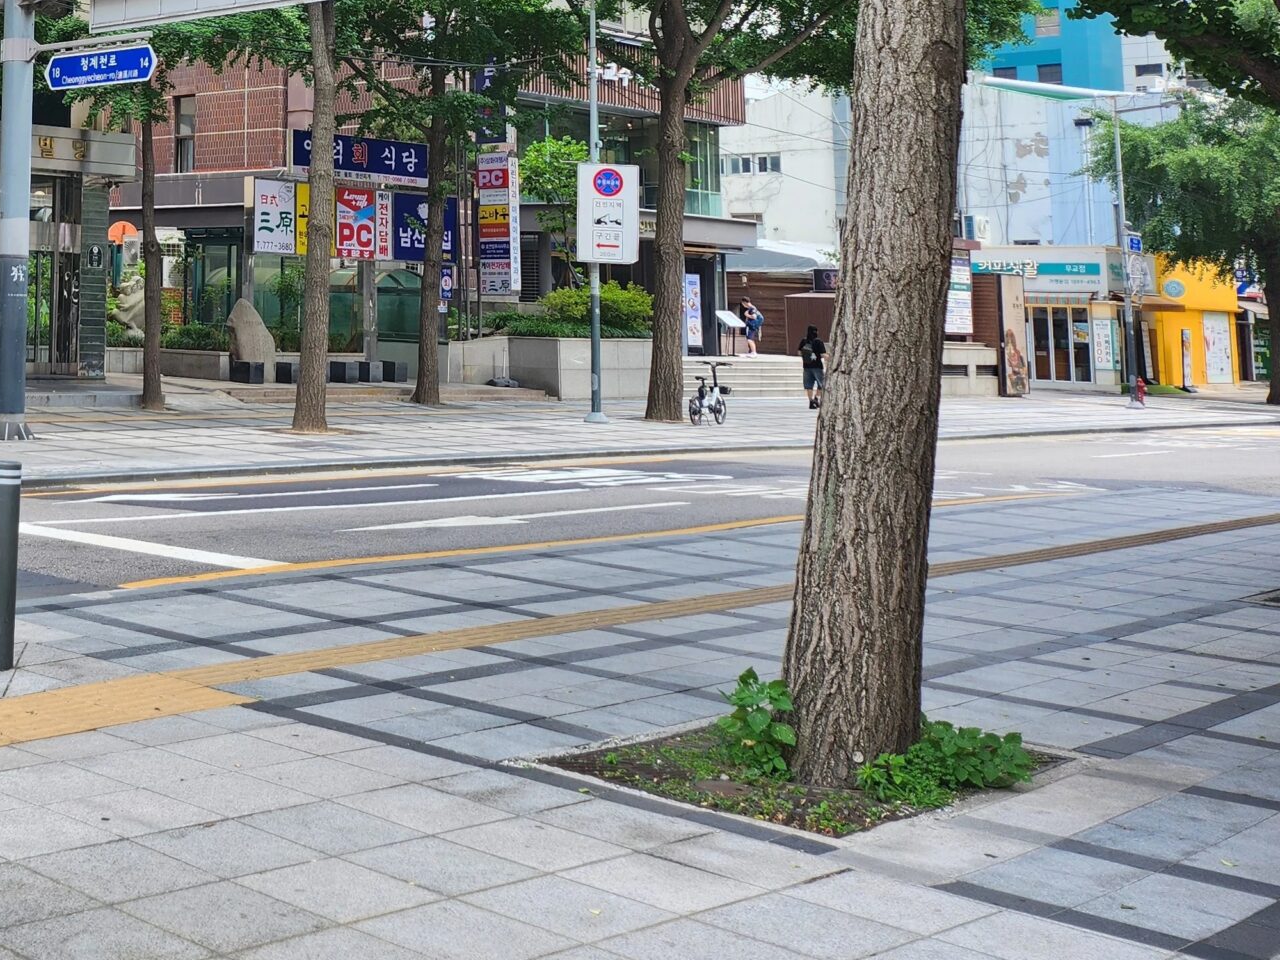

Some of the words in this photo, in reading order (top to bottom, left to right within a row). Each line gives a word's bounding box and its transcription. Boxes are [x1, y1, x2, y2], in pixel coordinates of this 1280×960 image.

[81, 54, 118, 71] 청계천로
[140, 56, 149, 69] 14
[51, 67, 60, 79] 18
[380, 145, 419, 173] 식당
[478, 170, 504, 187] PC
[261, 193, 279, 207] 日式
[377, 192, 390, 202] 케이
[479, 207, 509, 221] 고바우
[258, 211, 293, 237] 三原
[378, 203, 389, 257] 전자담배
[338, 222, 373, 248] PC
[977, 260, 1039, 280] 커피생활
[1064, 265, 1086, 273] 무교점
[488, 279, 510, 293] 三原
